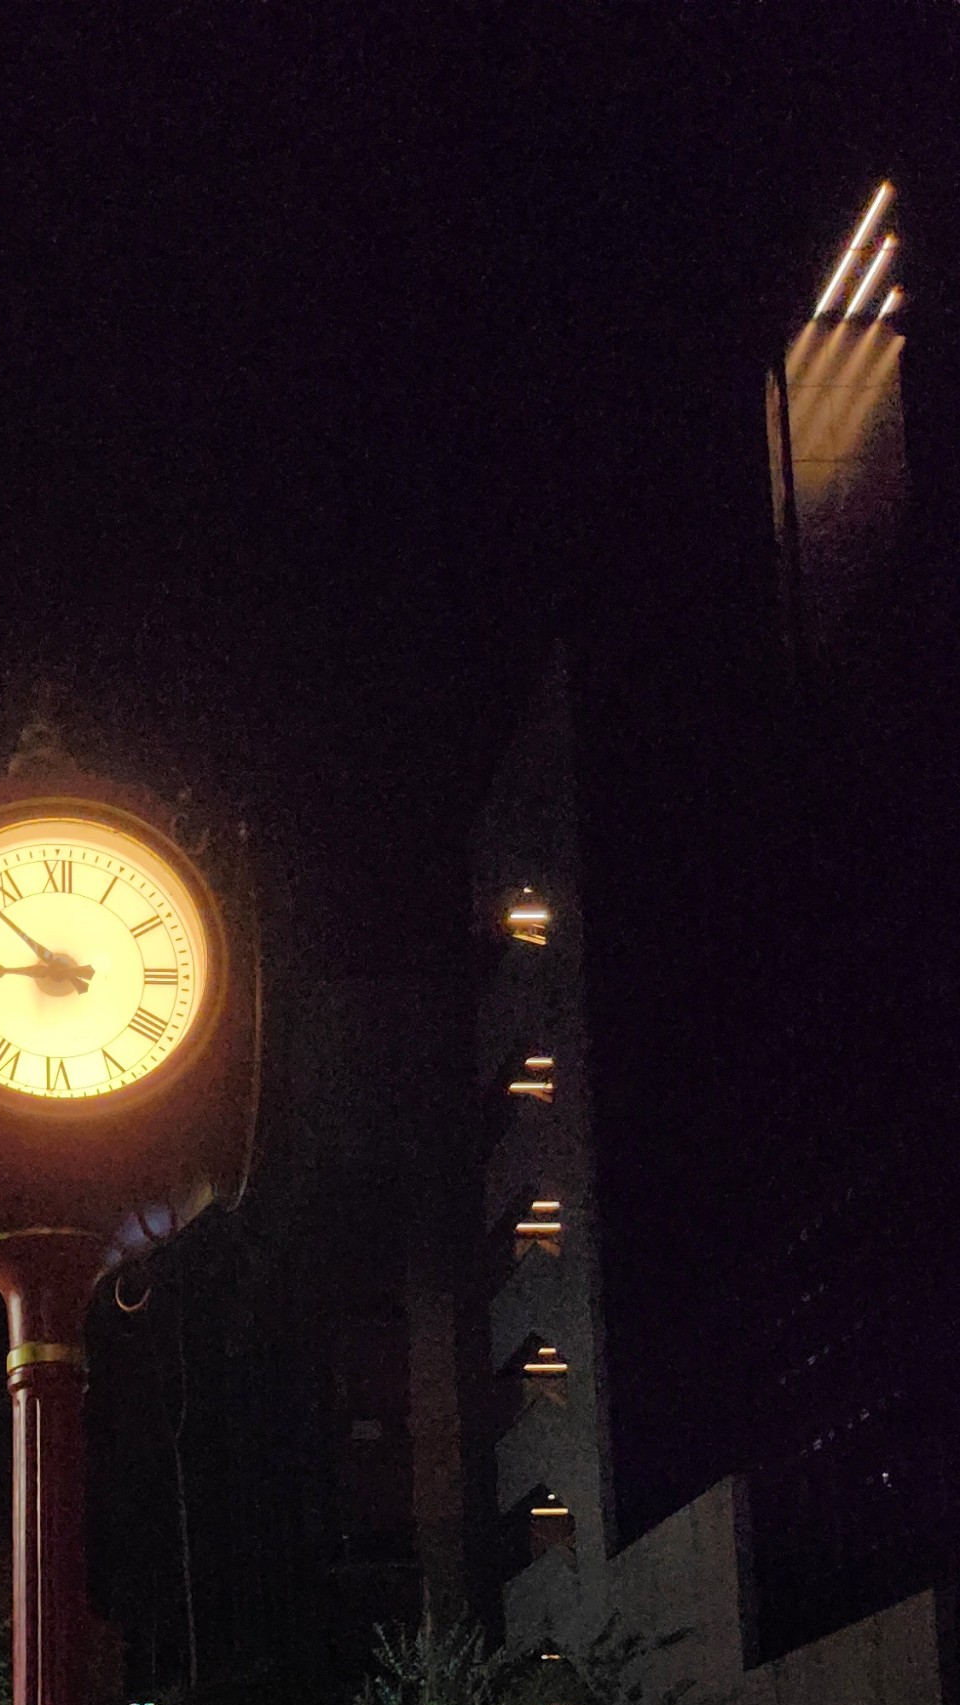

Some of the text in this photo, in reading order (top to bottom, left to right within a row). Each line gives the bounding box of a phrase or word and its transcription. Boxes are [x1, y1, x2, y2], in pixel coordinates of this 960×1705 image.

[42, 860, 73, 894] XII
[100, 876, 119, 904] I
[129, 915, 164, 938] II
[144, 968, 178, 985] III
[128, 1007, 168, 1043] IIII
[46, 1056, 71, 1091] VI
[102, 1048, 126, 1080] V
